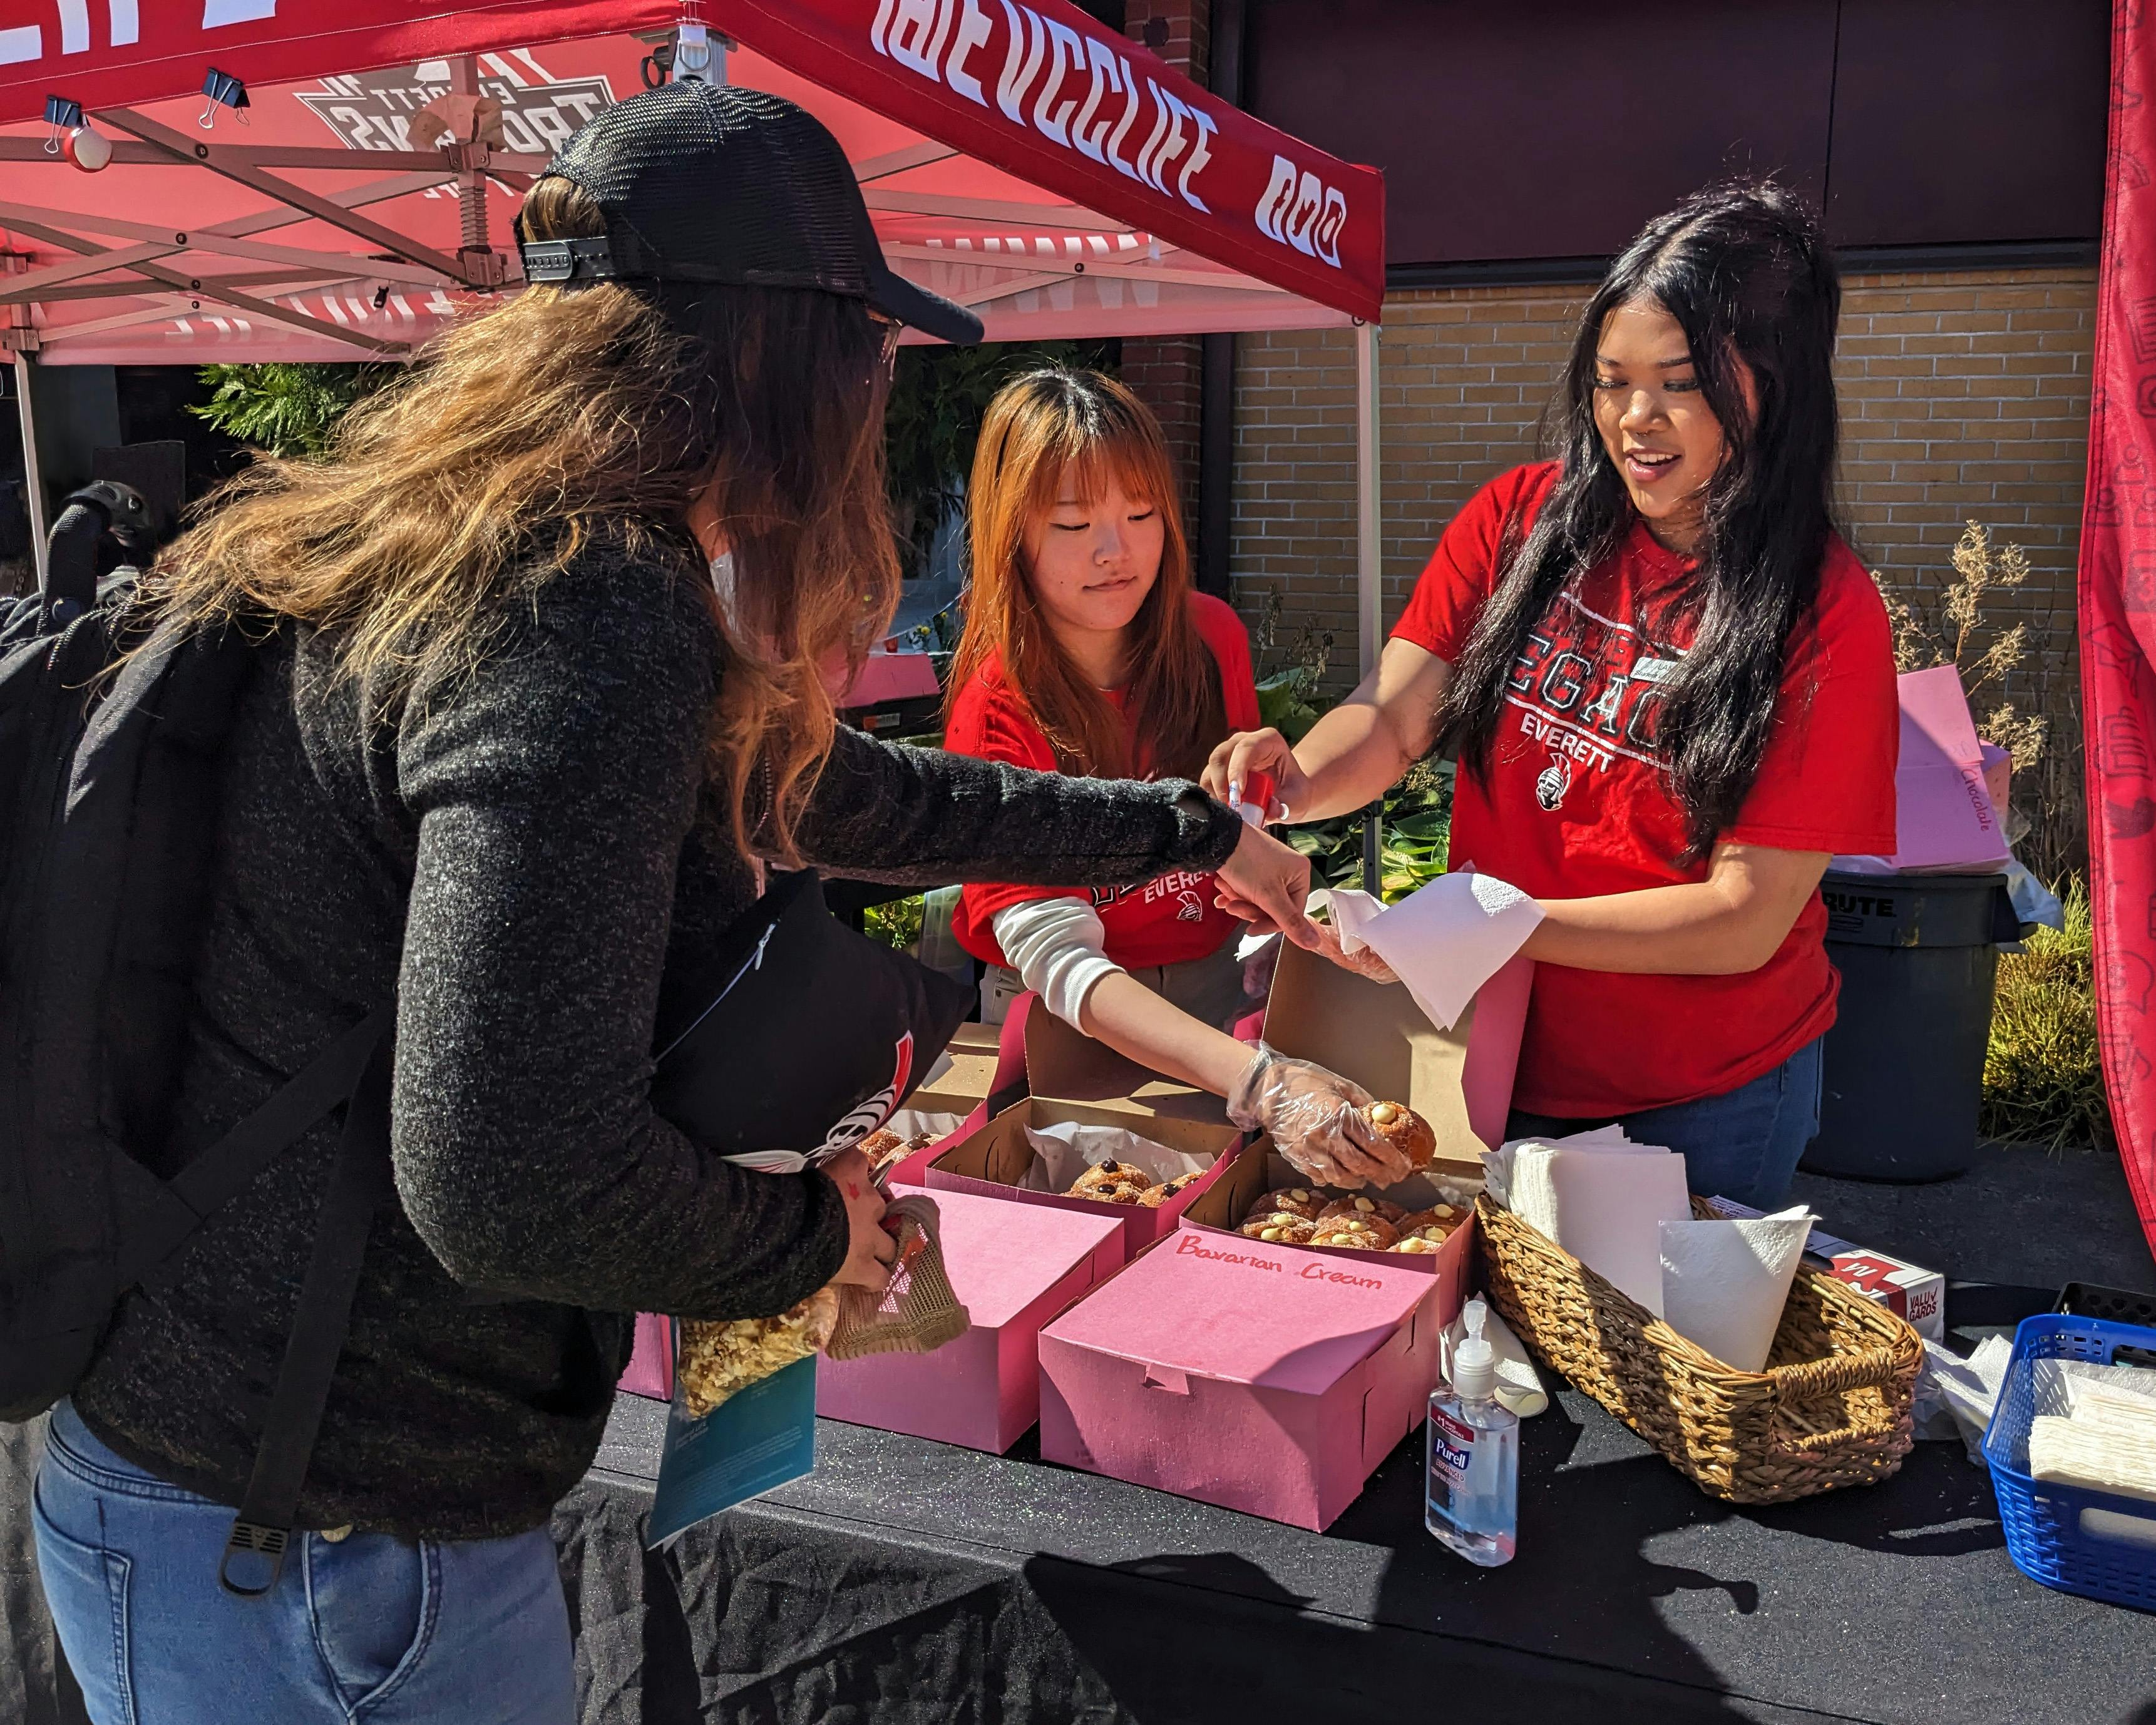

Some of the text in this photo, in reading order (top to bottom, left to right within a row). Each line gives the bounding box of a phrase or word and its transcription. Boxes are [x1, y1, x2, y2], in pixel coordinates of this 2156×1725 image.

[1504, 632, 1670, 749] EGAC
[1520, 714, 1616, 773] EVERETT
[1961, 768, 1991, 831] Chocolate
[1822, 892, 1894, 917] RUTE
[1176, 1235, 1382, 1289] Bavarian Cream
[1435, 1458, 1465, 1482] ADVANCED
[1436, 1438, 1466, 1468] Purell
